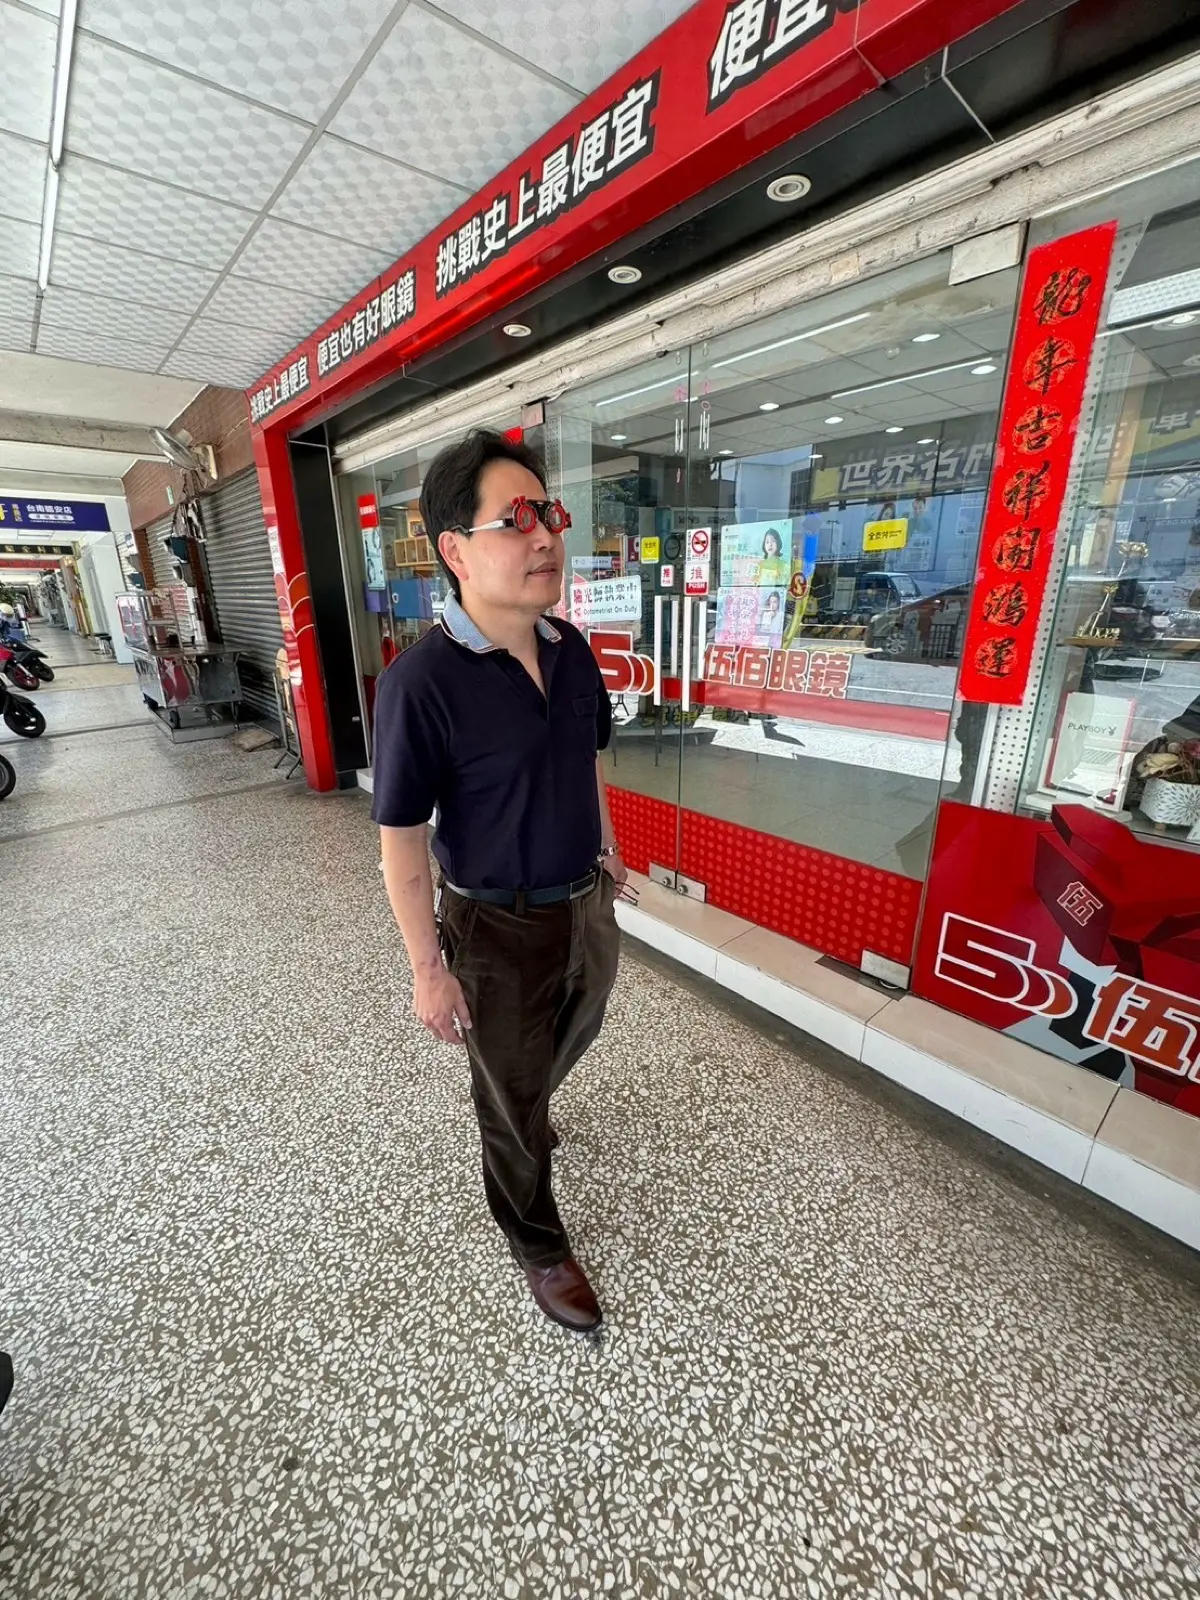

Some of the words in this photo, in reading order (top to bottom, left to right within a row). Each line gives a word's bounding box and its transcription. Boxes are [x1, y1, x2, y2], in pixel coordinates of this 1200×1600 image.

[251, 356, 309, 423] 挑戰史上最便宜
[318, 270, 414, 376] 便宜也有好眼鏡
[436, 80, 652, 292] 挑戰史上最便宜
[711, 0, 827, 100] 便宜
[583, 607, 613, 616] Optometrist
[624, 604, 637, 613] Duty
[703, 643, 852, 699] 伍佰眼鏡
[1067, 722, 1107, 734] PLAYBOY
[1057, 881, 1103, 926] 伍
[1082, 972, 1200, 1083] 伍
